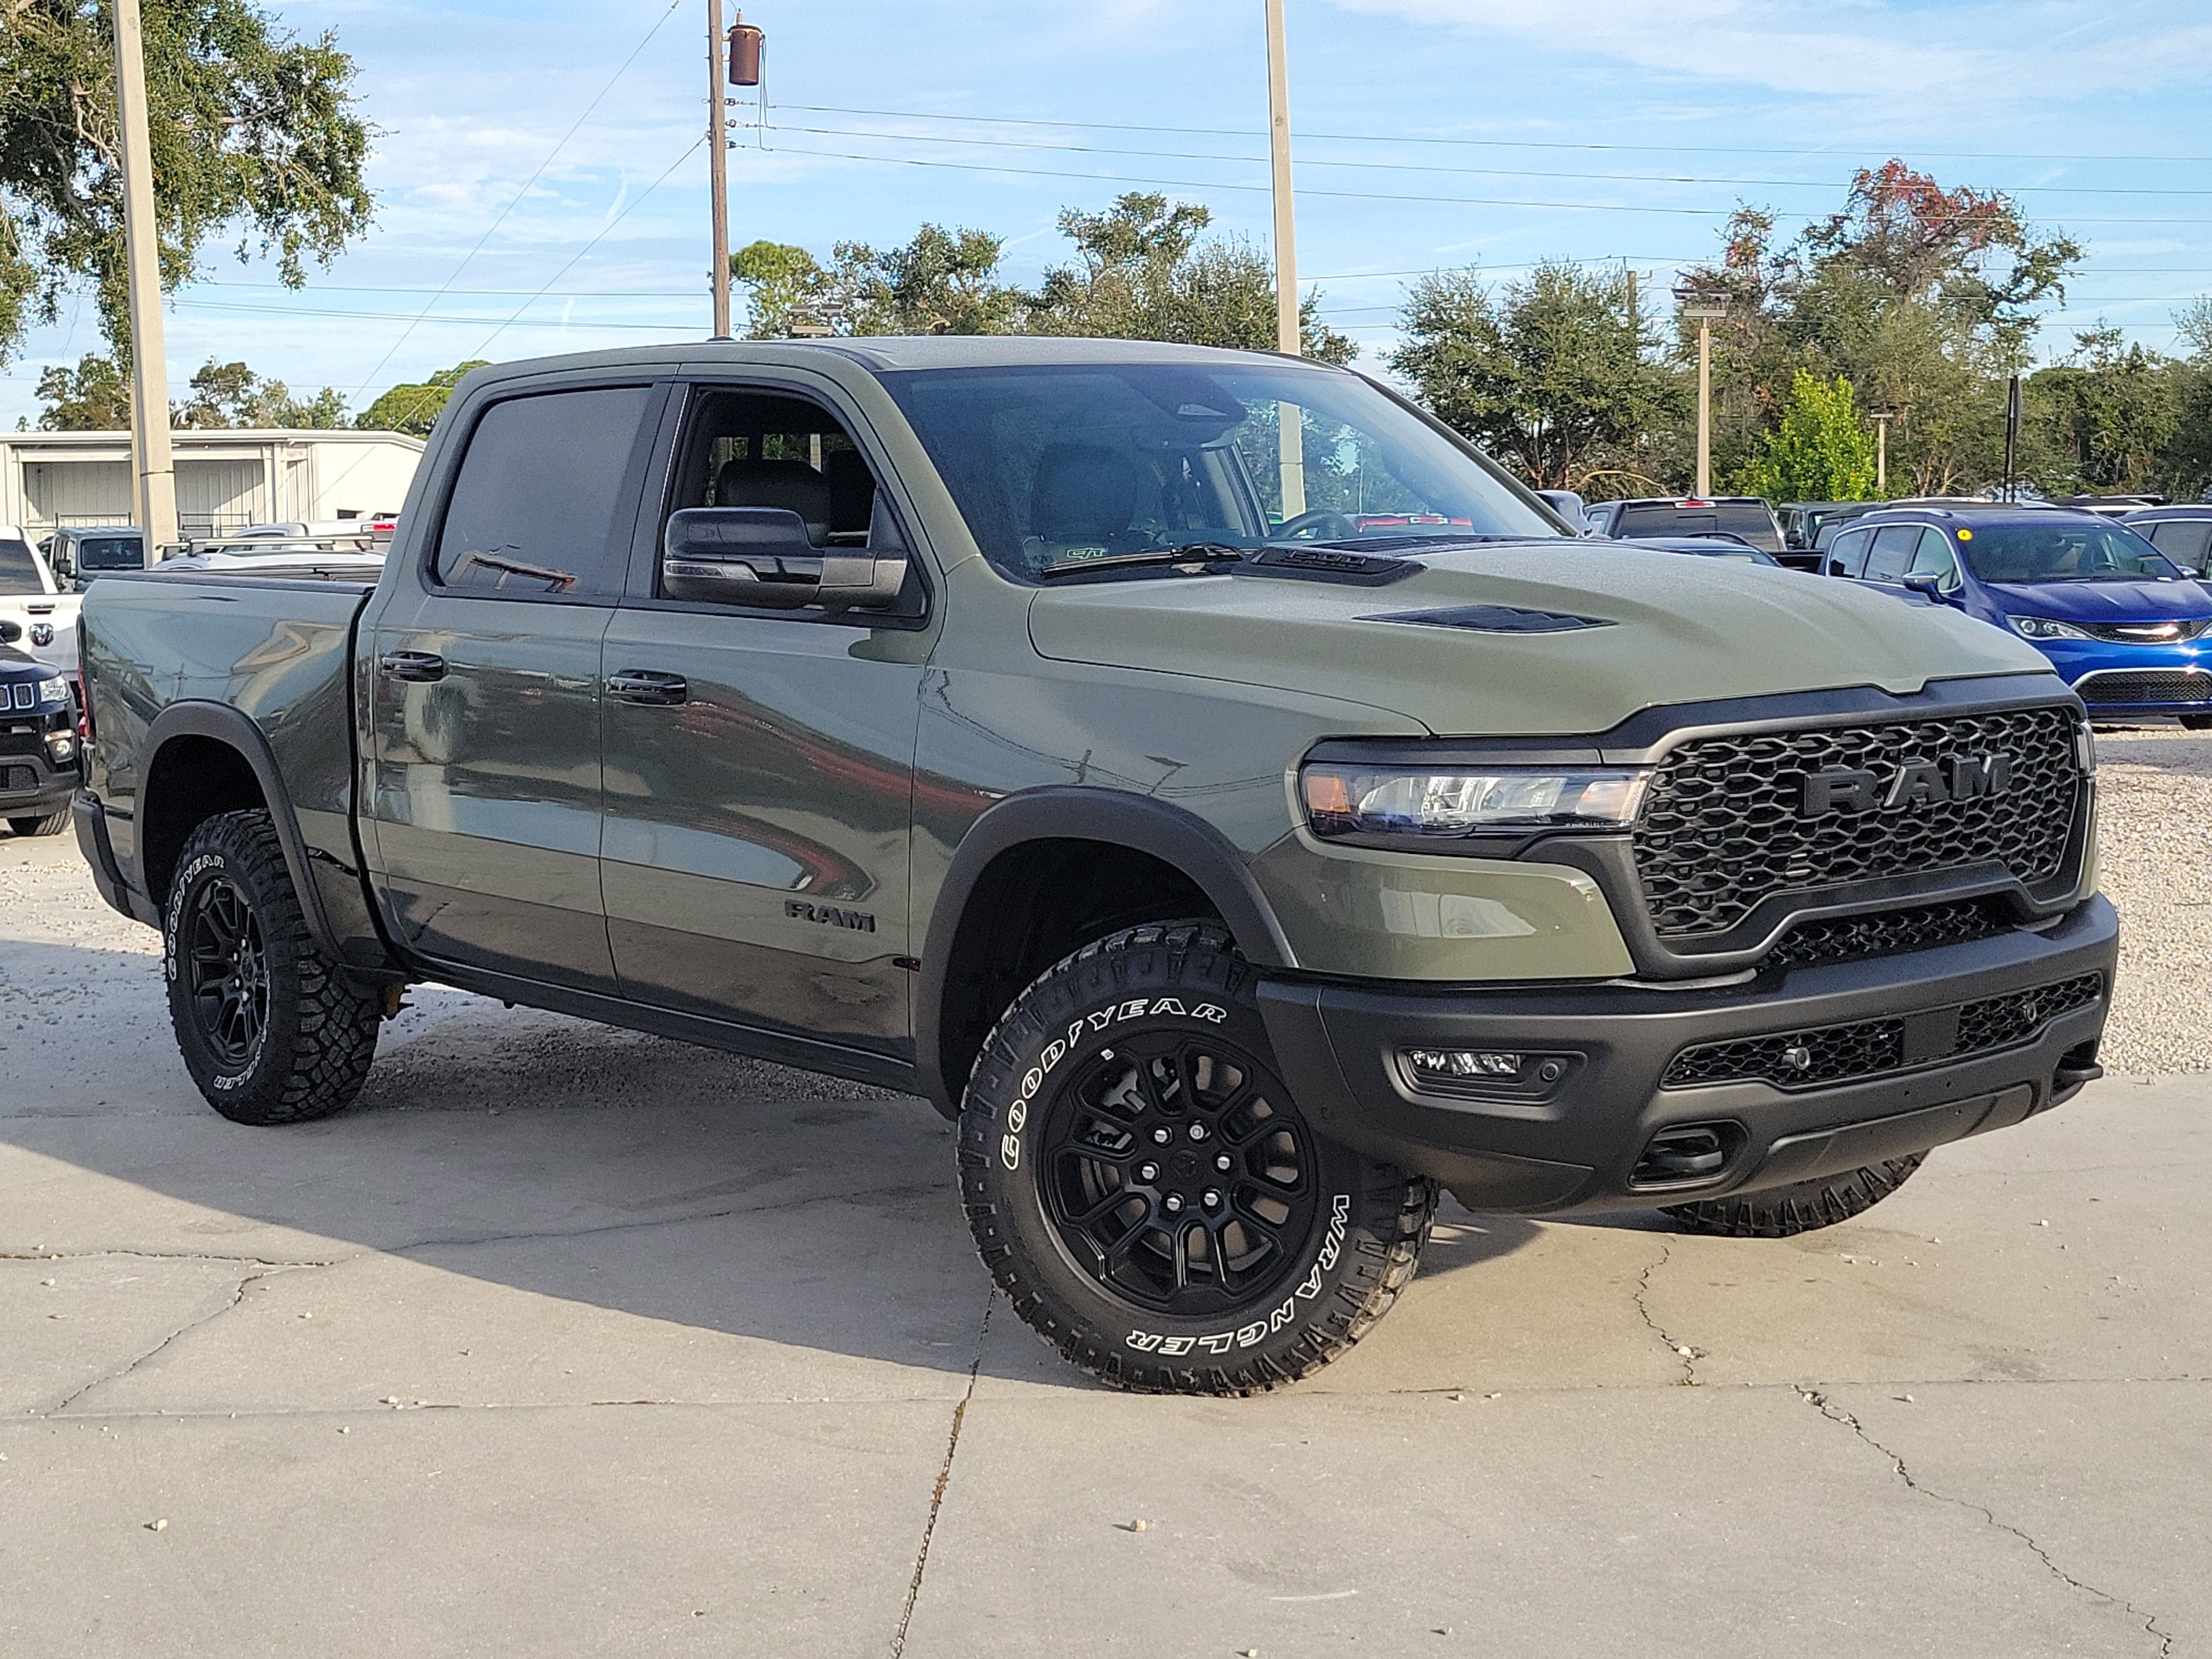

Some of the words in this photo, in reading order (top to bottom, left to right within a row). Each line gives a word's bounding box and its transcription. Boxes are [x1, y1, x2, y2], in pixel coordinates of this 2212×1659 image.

[1803, 751, 2011, 815] RAM
[167, 854, 225, 980] GOODYEAR
[784, 899, 876, 933] RAM
[1001, 997, 1227, 1170] GOODYEAR
[1126, 1194, 1350, 1356] WRANGLER
